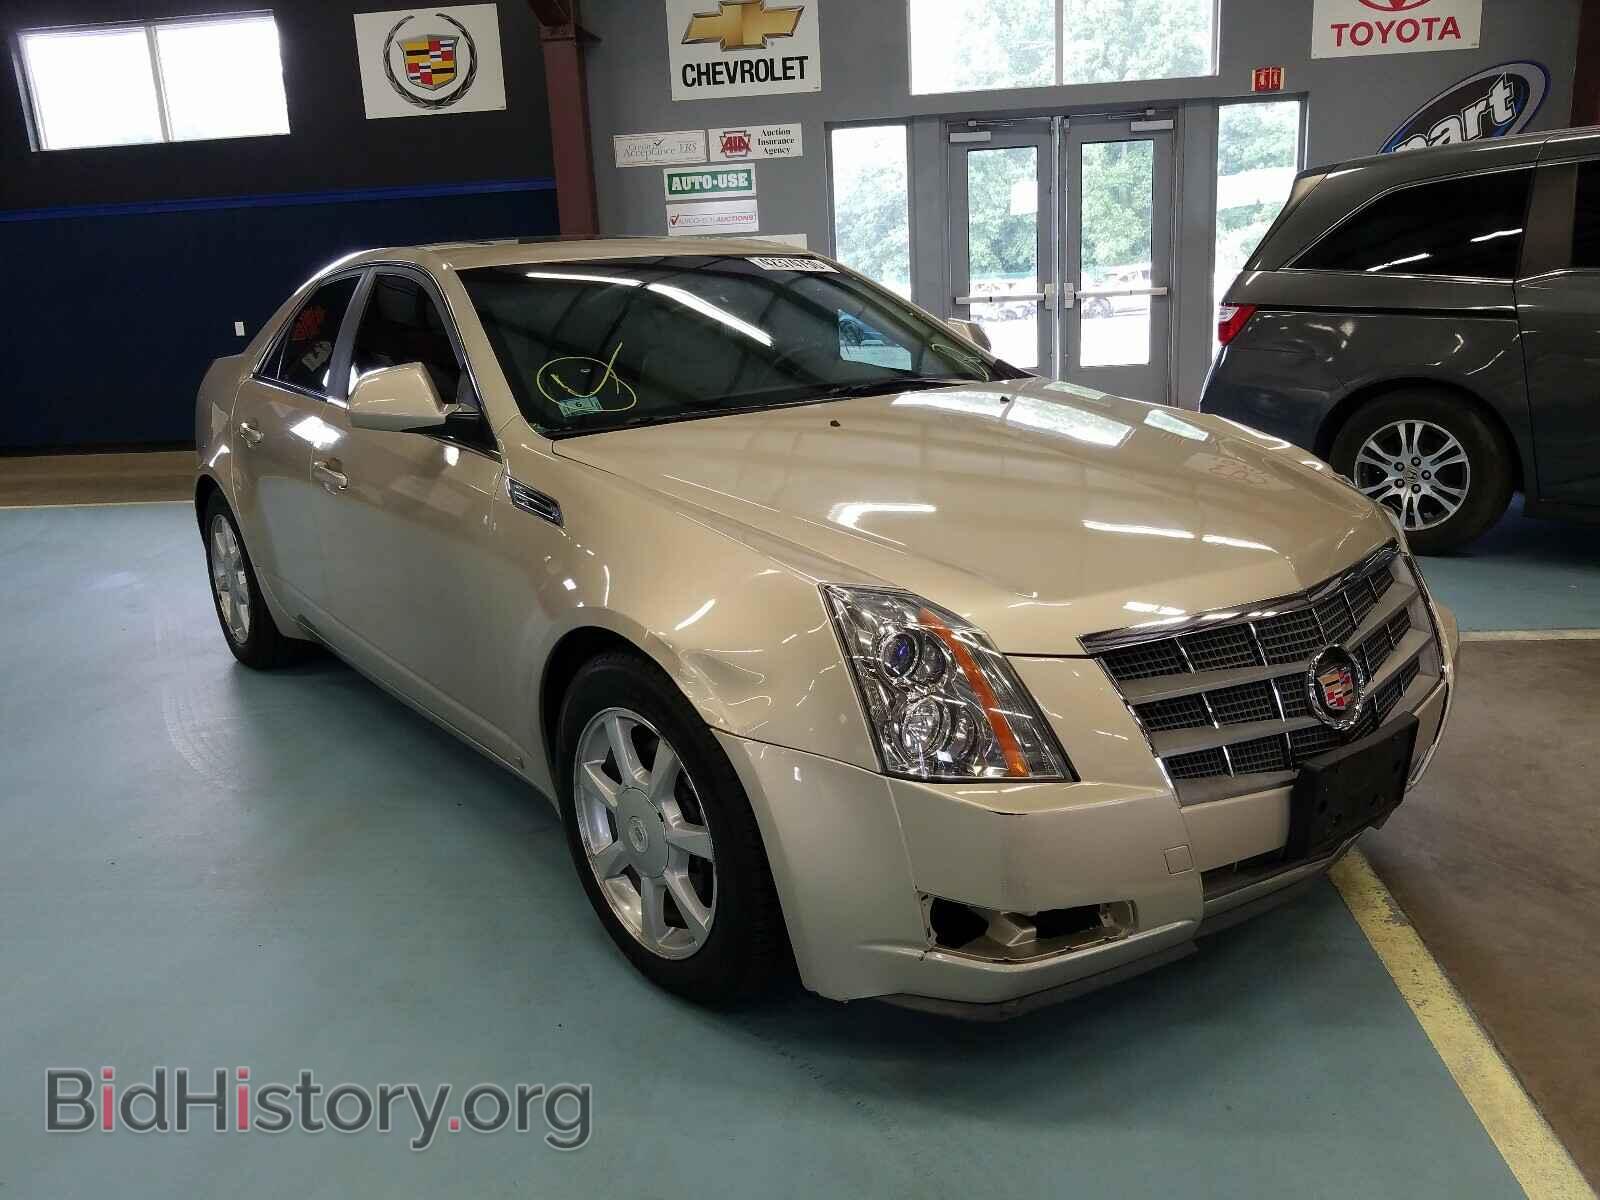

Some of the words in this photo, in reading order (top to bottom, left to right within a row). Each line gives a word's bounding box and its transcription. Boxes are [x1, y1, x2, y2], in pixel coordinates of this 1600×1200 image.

[1330, 16, 1462, 47] TOYOTA
[681, 56, 809, 88] CHEVROLET
[761, 128, 791, 137] Auction
[757, 138, 795, 146] Insurance
[763, 147, 791, 155] Agency
